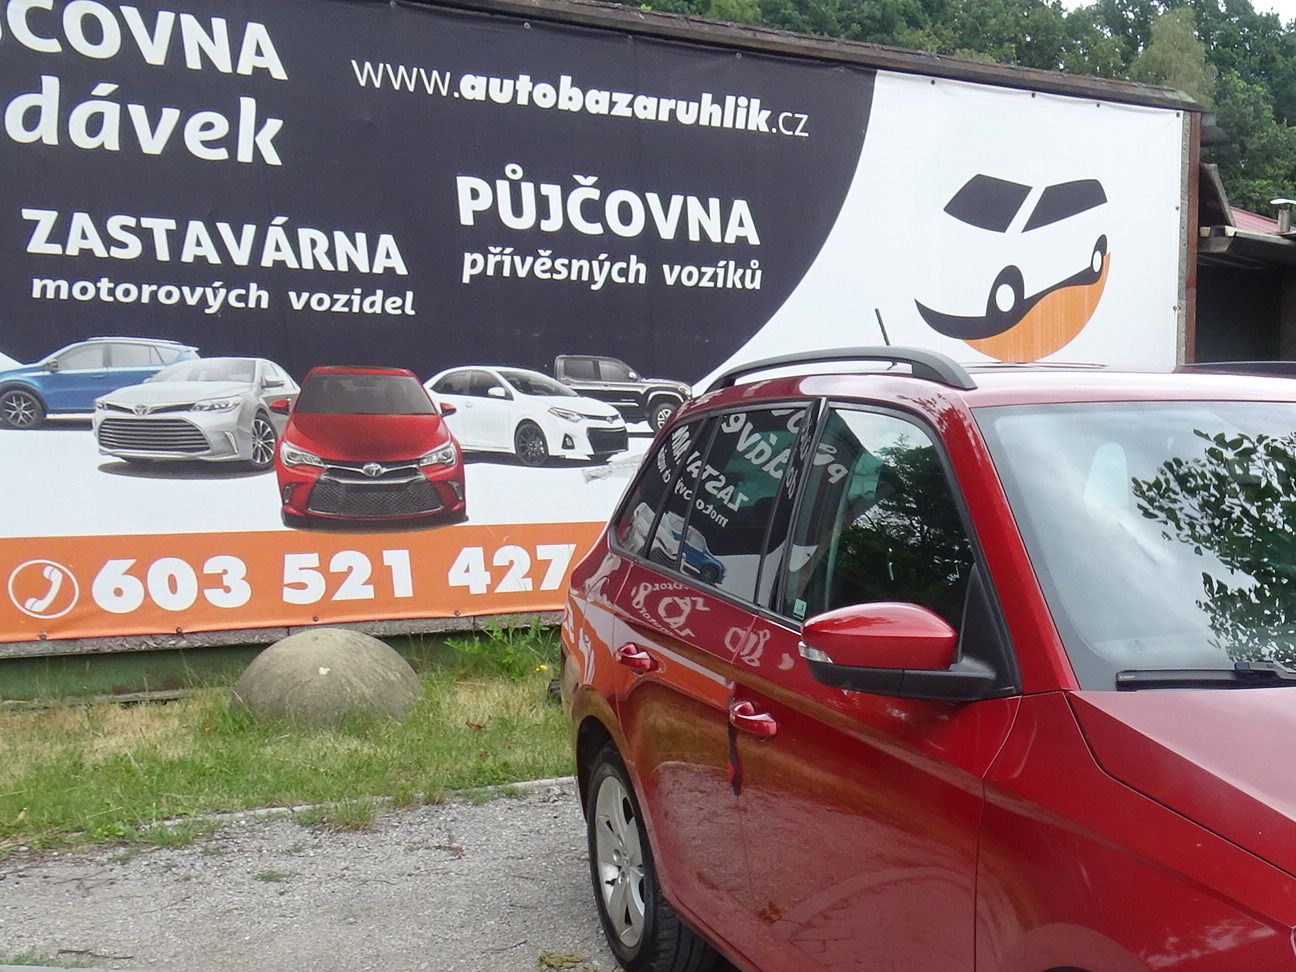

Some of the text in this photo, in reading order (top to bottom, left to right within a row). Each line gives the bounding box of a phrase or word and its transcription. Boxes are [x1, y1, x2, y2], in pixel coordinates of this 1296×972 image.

[4, 75, 284, 166] dávek
[350, 59, 810, 137] www.autobazaruhlik.cz
[455, 163, 761, 246] PŮJČOVNA
[21, 208, 409, 276] ZASTAVÁRNA
[462, 246, 763, 291] přívěsných vozíků
[32, 277, 416, 316] motorových vozidel
[91, 543, 577, 614] 603 521 427
